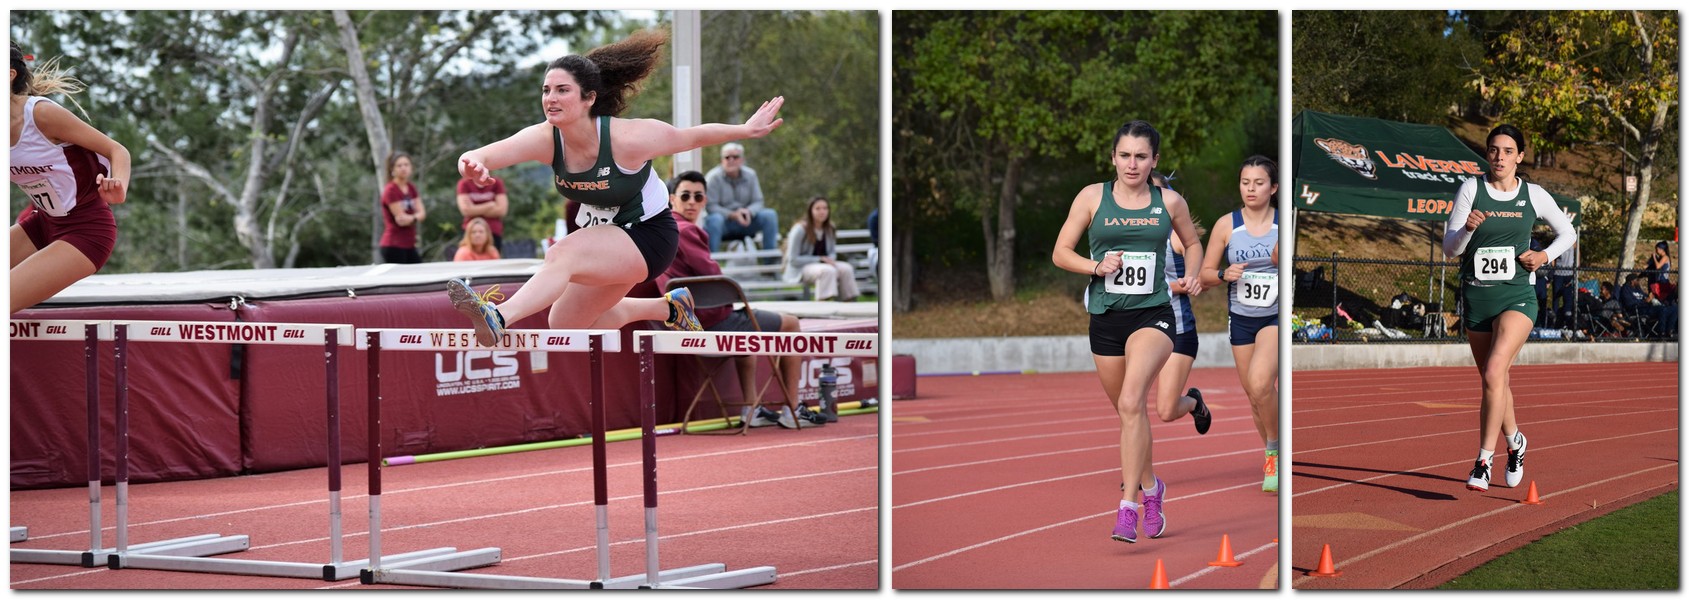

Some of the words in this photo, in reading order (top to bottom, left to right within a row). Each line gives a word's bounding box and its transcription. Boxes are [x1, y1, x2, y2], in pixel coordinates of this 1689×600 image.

[1402, 169, 1442, 182] track
[1235, 248, 1271, 262] ROYA
[1481, 257, 1508, 274] 294
[1113, 266, 1147, 287] 289
[1244, 282, 1271, 301] 397
[46, 325, 67, 334] GILL
[150, 327, 171, 336] GILL
[178, 324, 277, 341] WESTMONT
[283, 329, 305, 338] GILL
[399, 334, 422, 344] GILL
[430, 332, 540, 348] WESTONT
[547, 336, 571, 346] GILL
[681, 338, 707, 348] GILL
[715, 335, 838, 353] WESTMONT
[845, 339, 873, 350] GILL
[435, 350, 519, 383] UCS
